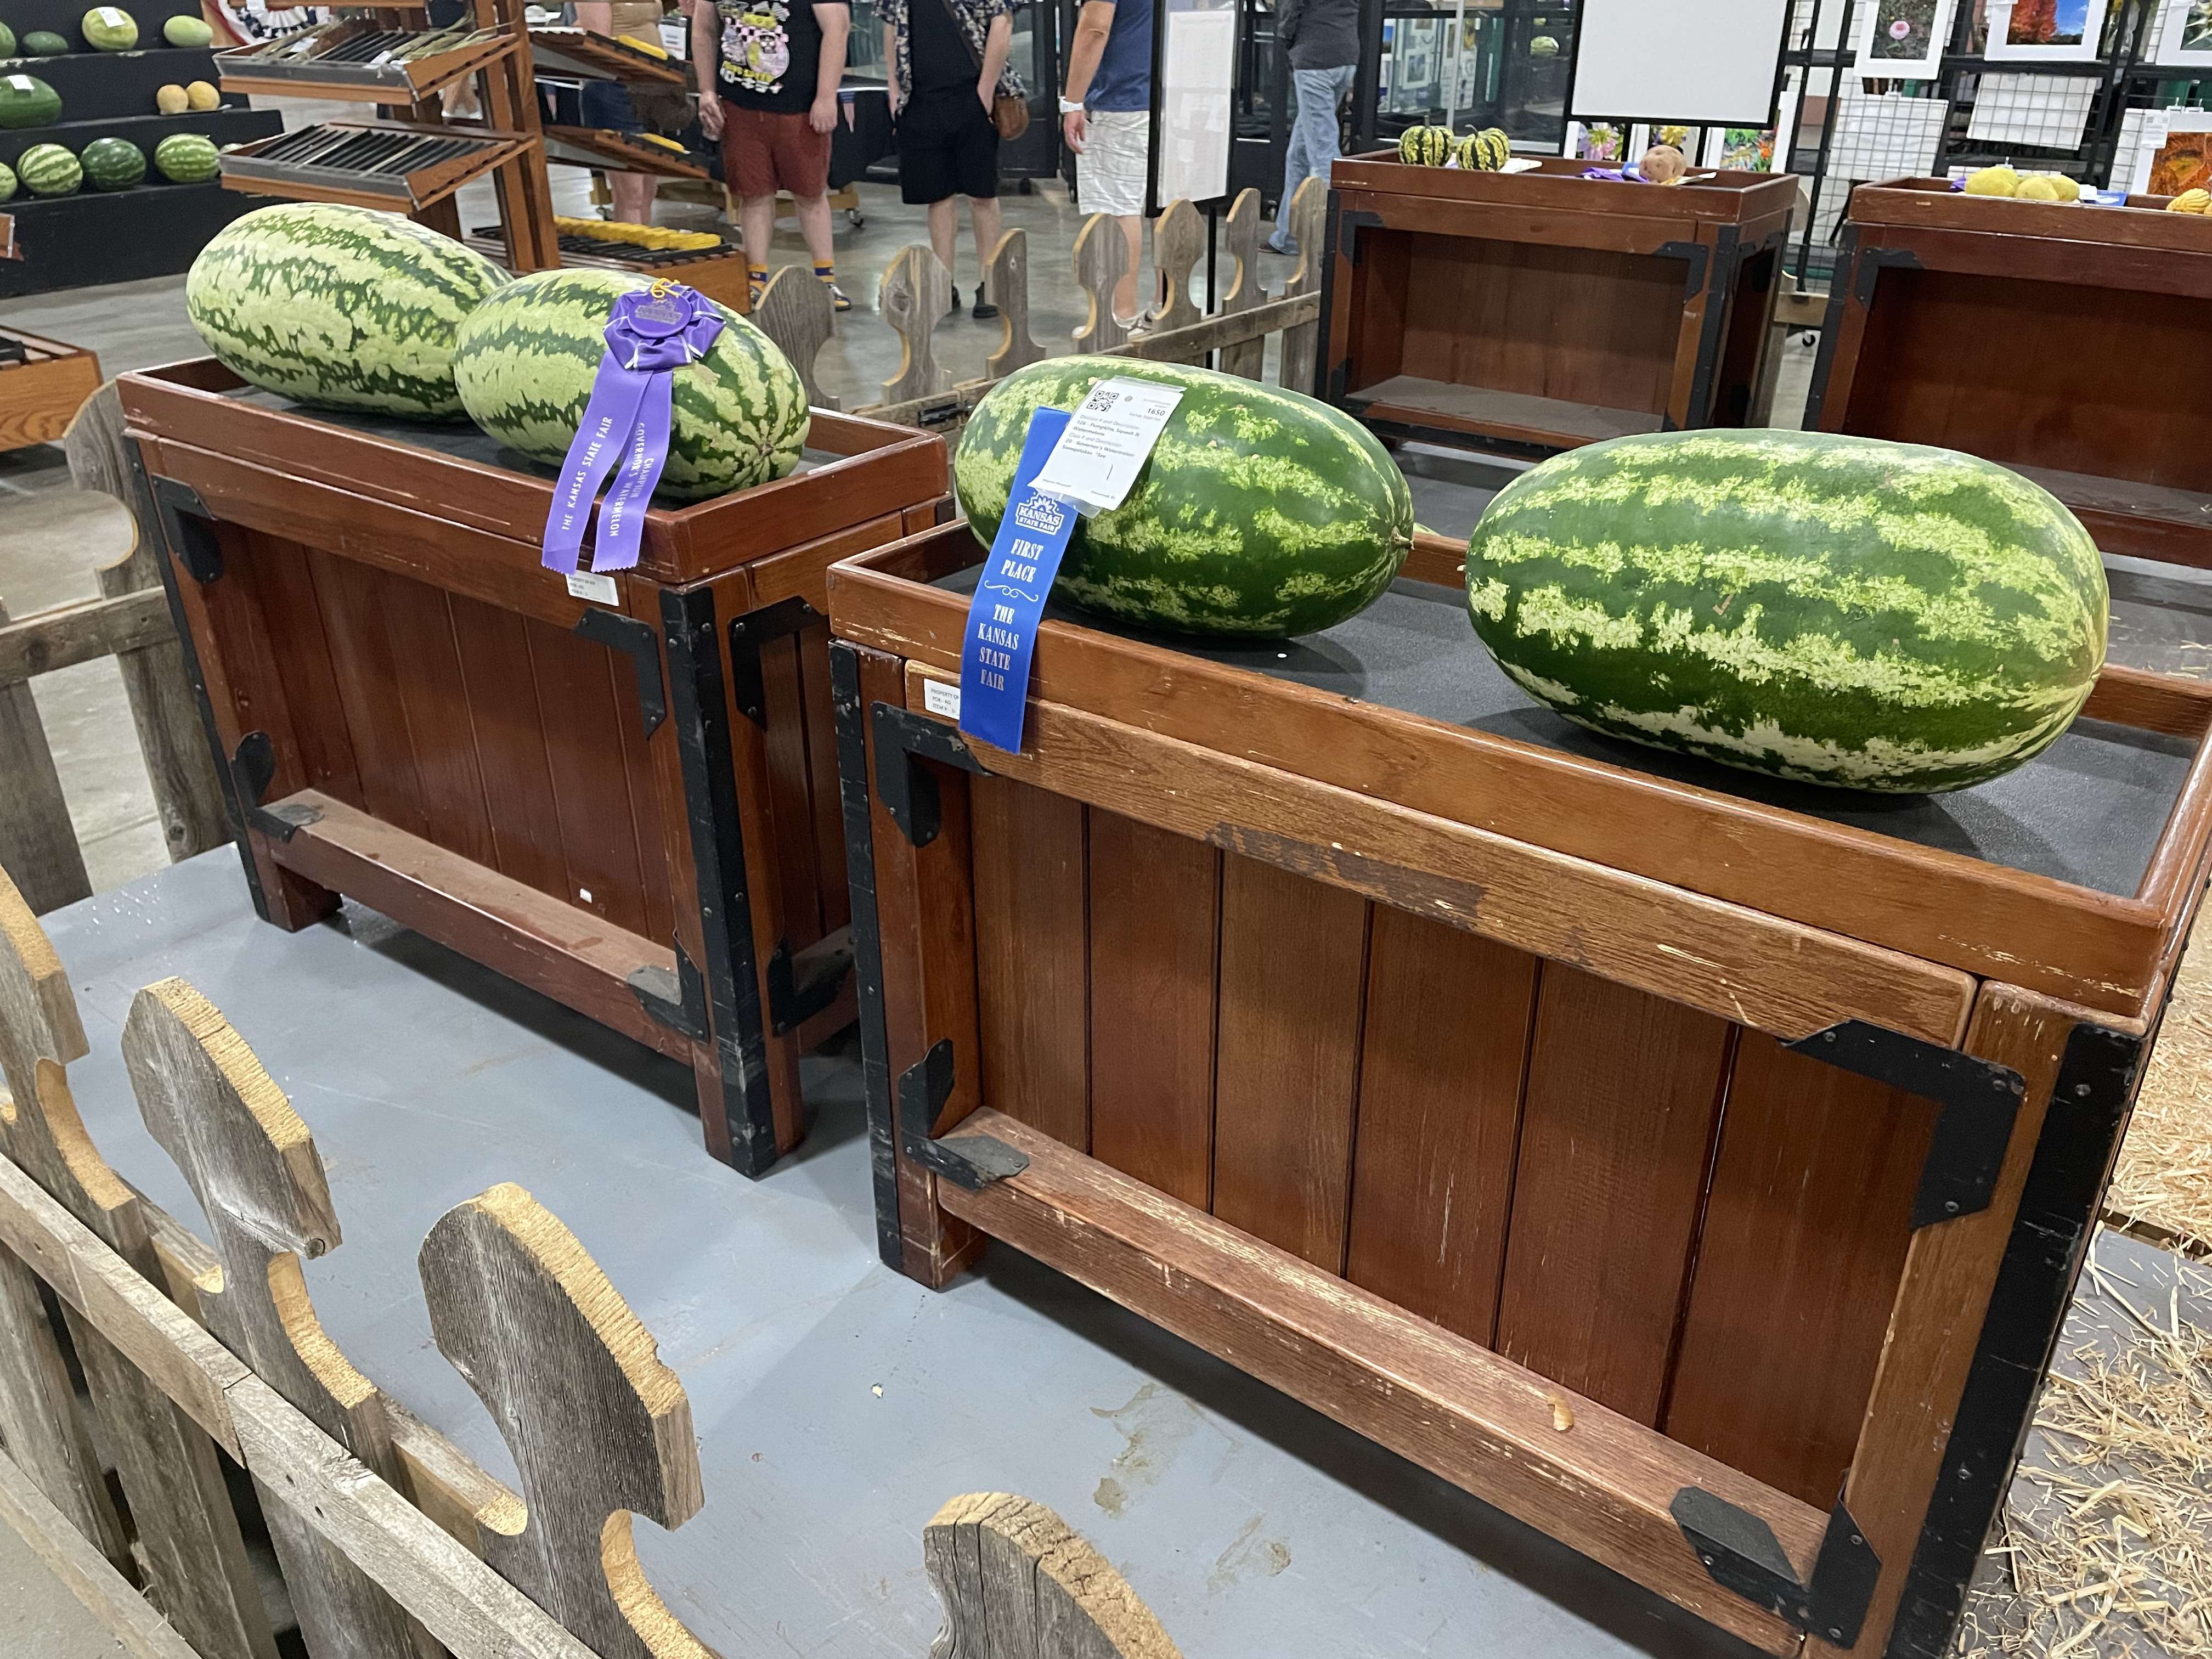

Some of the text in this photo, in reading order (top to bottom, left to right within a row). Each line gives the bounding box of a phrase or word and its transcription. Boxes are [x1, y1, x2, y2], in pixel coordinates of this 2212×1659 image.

[1147, 408, 1165, 416] 1650
[1073, 426, 1105, 437] Watermelons
[1104, 447, 1135, 458] Watermelon
[562, 416, 613, 531] THE KANSAS STATE FAIR
[629, 458, 654, 498] CHAMPION
[610, 481, 633, 537] WATERMELON
[1018, 506, 1061, 526] KANSAS
[1019, 517, 1055, 531] STATE FAIR
[1011, 538, 1044, 561] FIRST
[1001, 559, 1036, 583] PLACE
[993, 603, 1015, 624] THE
[978, 623, 1019, 650] KANSAS
[979, 646, 1011, 671] STATE
[980, 668, 1004, 691] FAIR
[931, 688, 953, 698] PROPERTY
